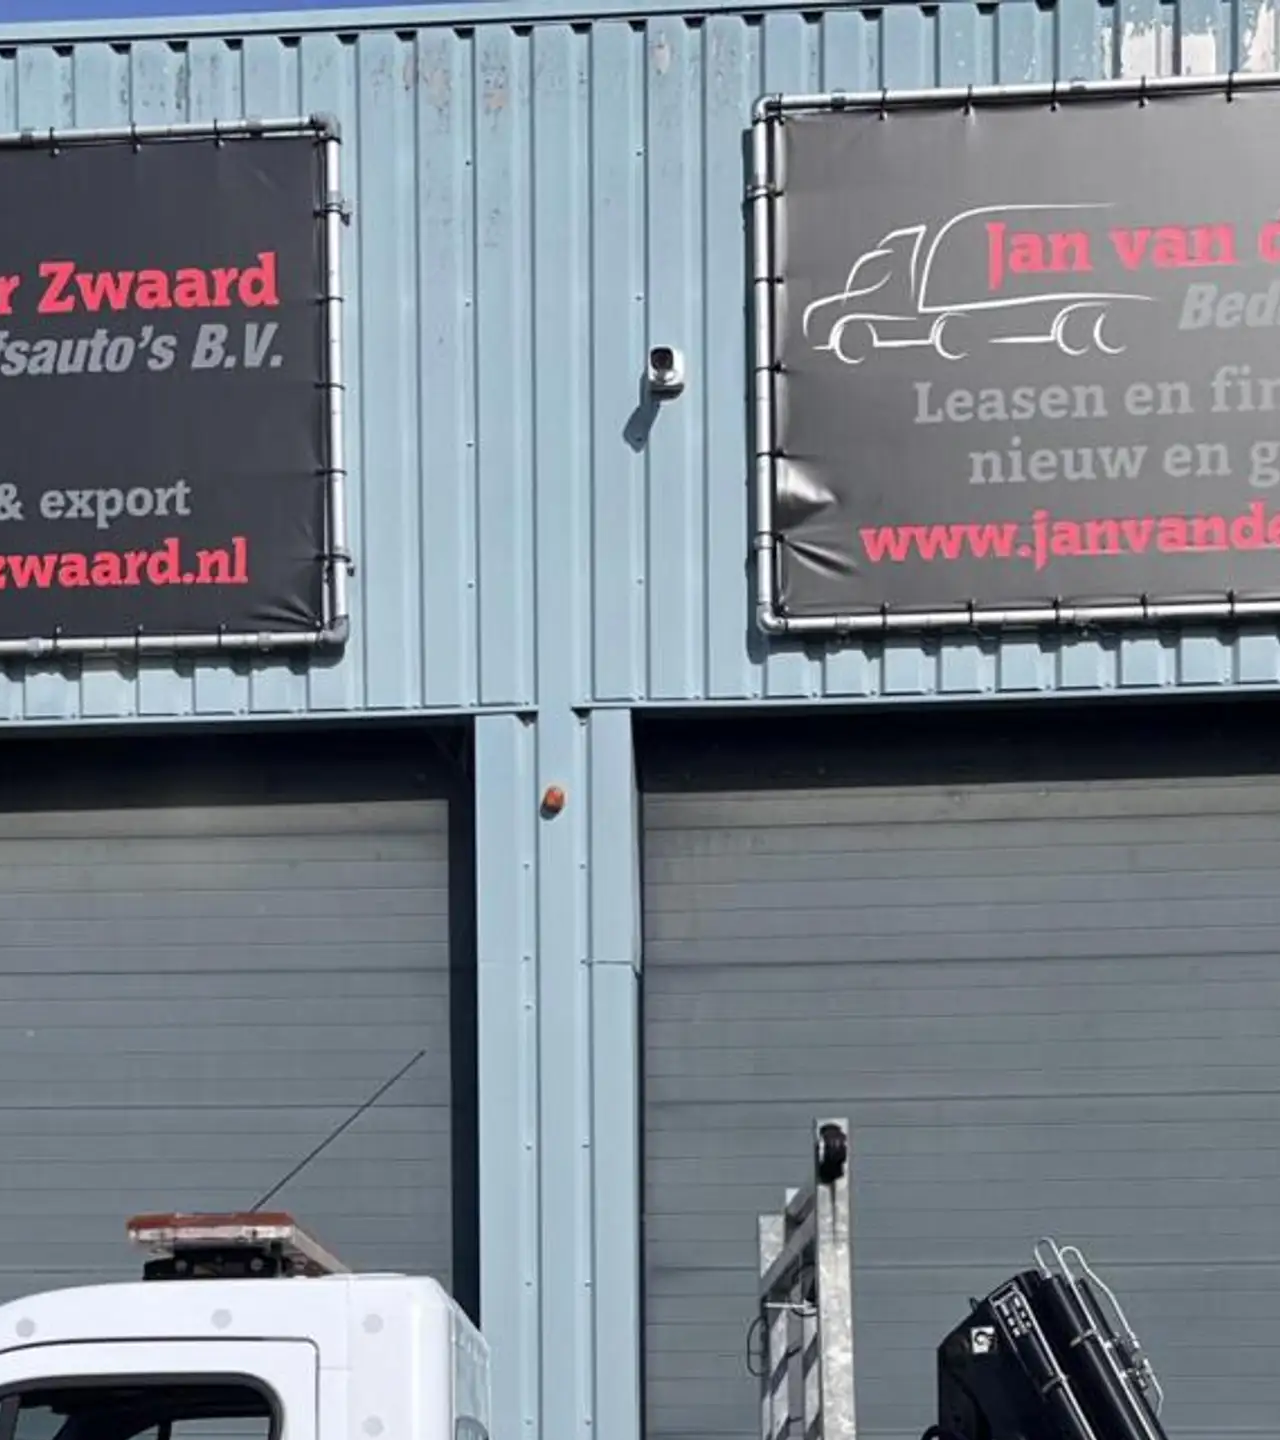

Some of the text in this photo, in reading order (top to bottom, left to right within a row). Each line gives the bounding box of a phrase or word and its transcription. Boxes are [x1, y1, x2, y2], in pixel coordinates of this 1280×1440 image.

[988, 221, 1092, 290] Jan
[1111, 222, 1238, 270] van
[38, 250, 280, 316] Zwaard
[190, 321, 284, 370] B.V.
[913, 381, 1108, 425] Leasen
[1123, 382, 1195, 416] en
[968, 436, 1148, 485] nieuw
[1162, 441, 1233, 478] en
[40, 479, 192, 530] export
